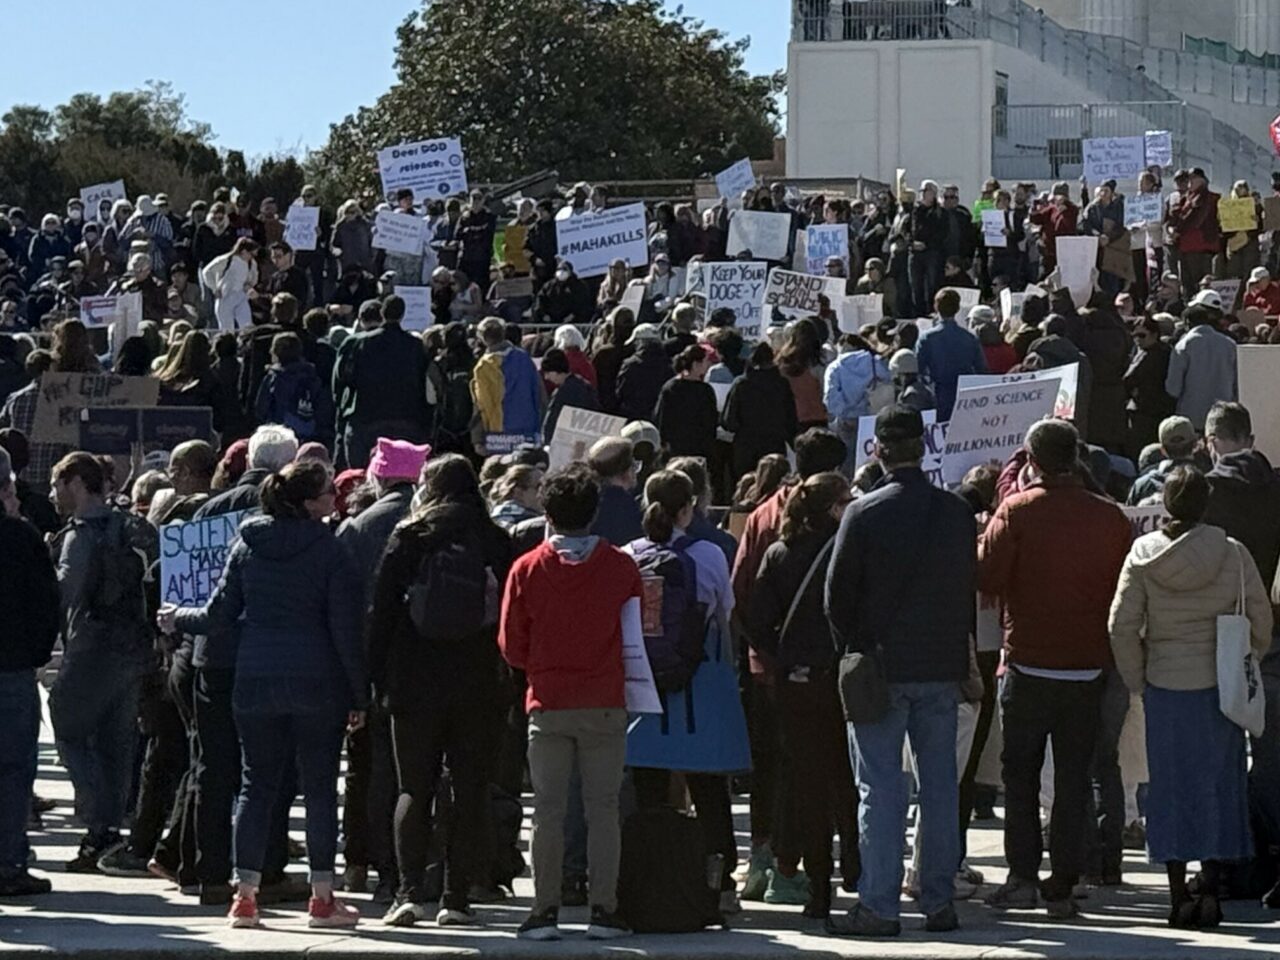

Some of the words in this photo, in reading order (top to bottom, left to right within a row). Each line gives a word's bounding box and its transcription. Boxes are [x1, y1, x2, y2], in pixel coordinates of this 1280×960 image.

[561, 228, 644, 256] #MAHAKILLS
[711, 265, 737, 281] KEEP
[738, 264, 767, 281] YOUR
[772, 271, 823, 291] STAND
[766, 292, 819, 312] SCIENCE
[956, 395, 989, 411] FUND
[994, 389, 1044, 406] SCIENCE
[980, 414, 1009, 428] NOT
[944, 431, 1025, 456] BILLIONAIRE
[165, 566, 224, 601] AMER
